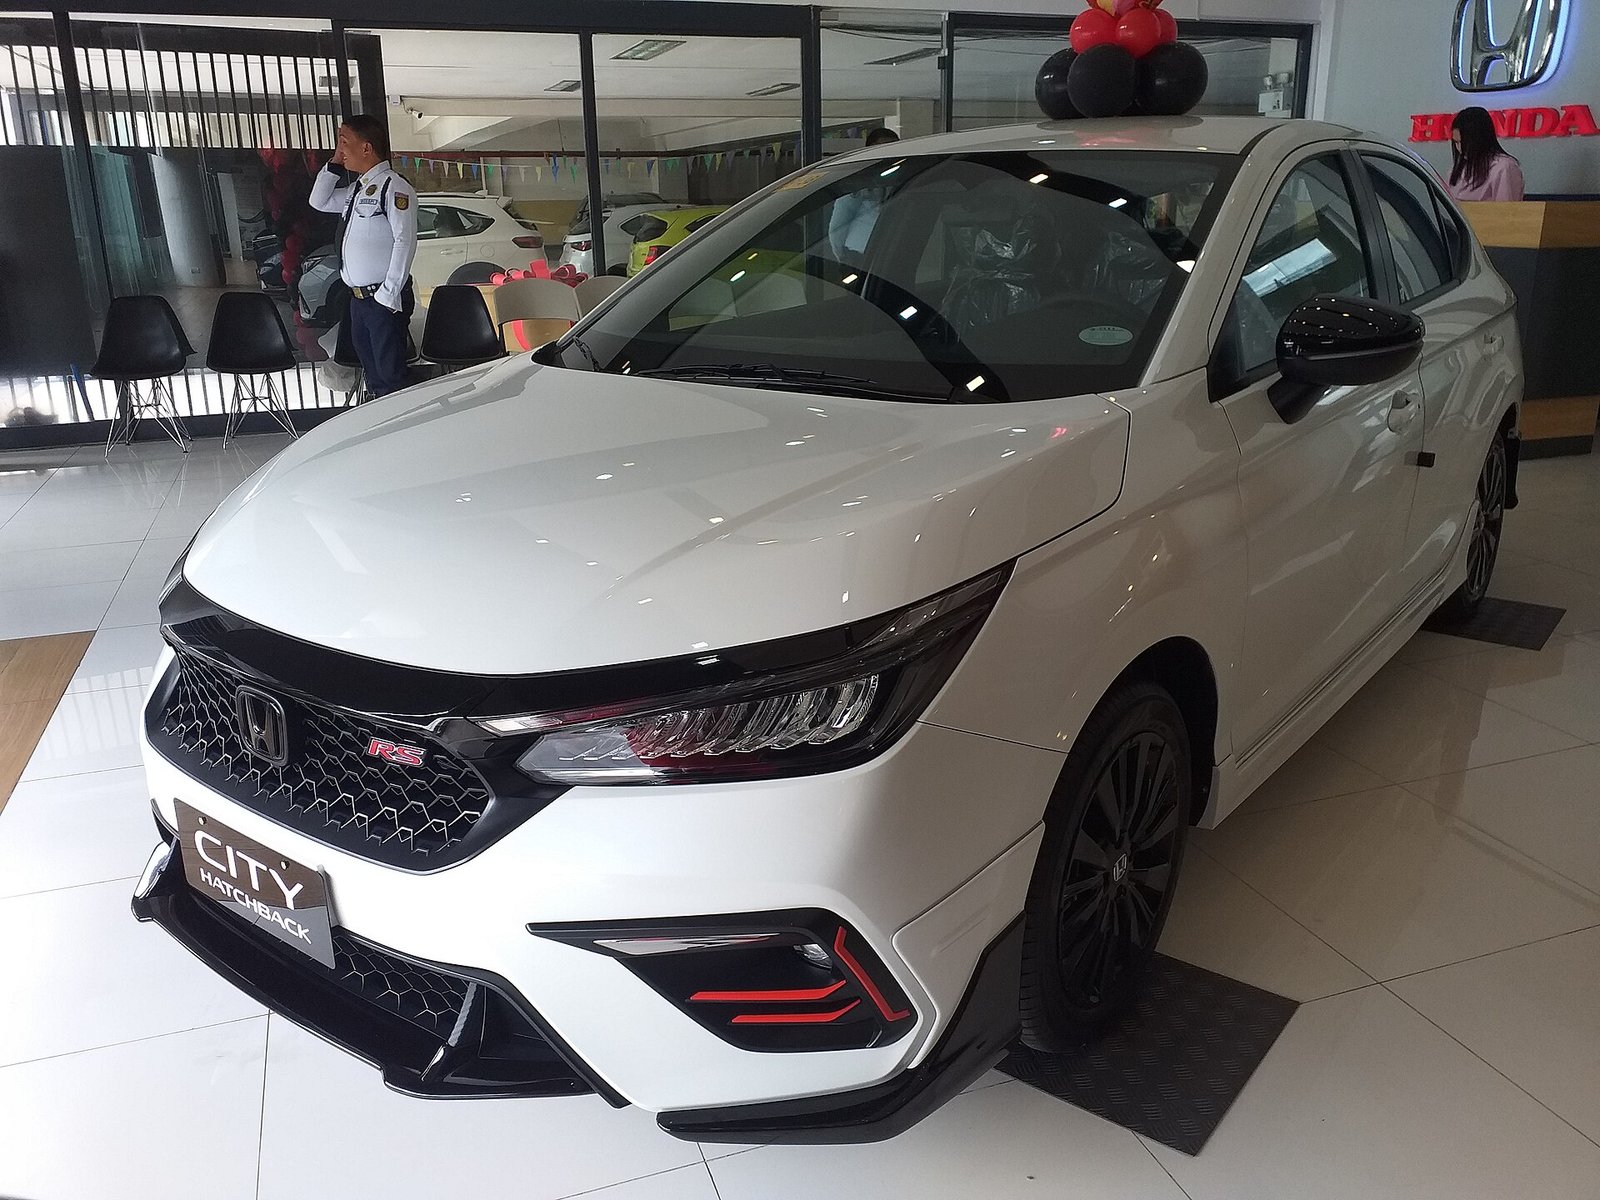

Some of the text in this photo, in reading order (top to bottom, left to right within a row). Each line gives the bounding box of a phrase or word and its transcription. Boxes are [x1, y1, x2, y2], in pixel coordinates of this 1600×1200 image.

[1408, 104, 1600, 143] HNDA
[367, 737, 426, 767] RS
[194, 830, 304, 911] CITY
[200, 867, 312, 945] HATCHBACK
